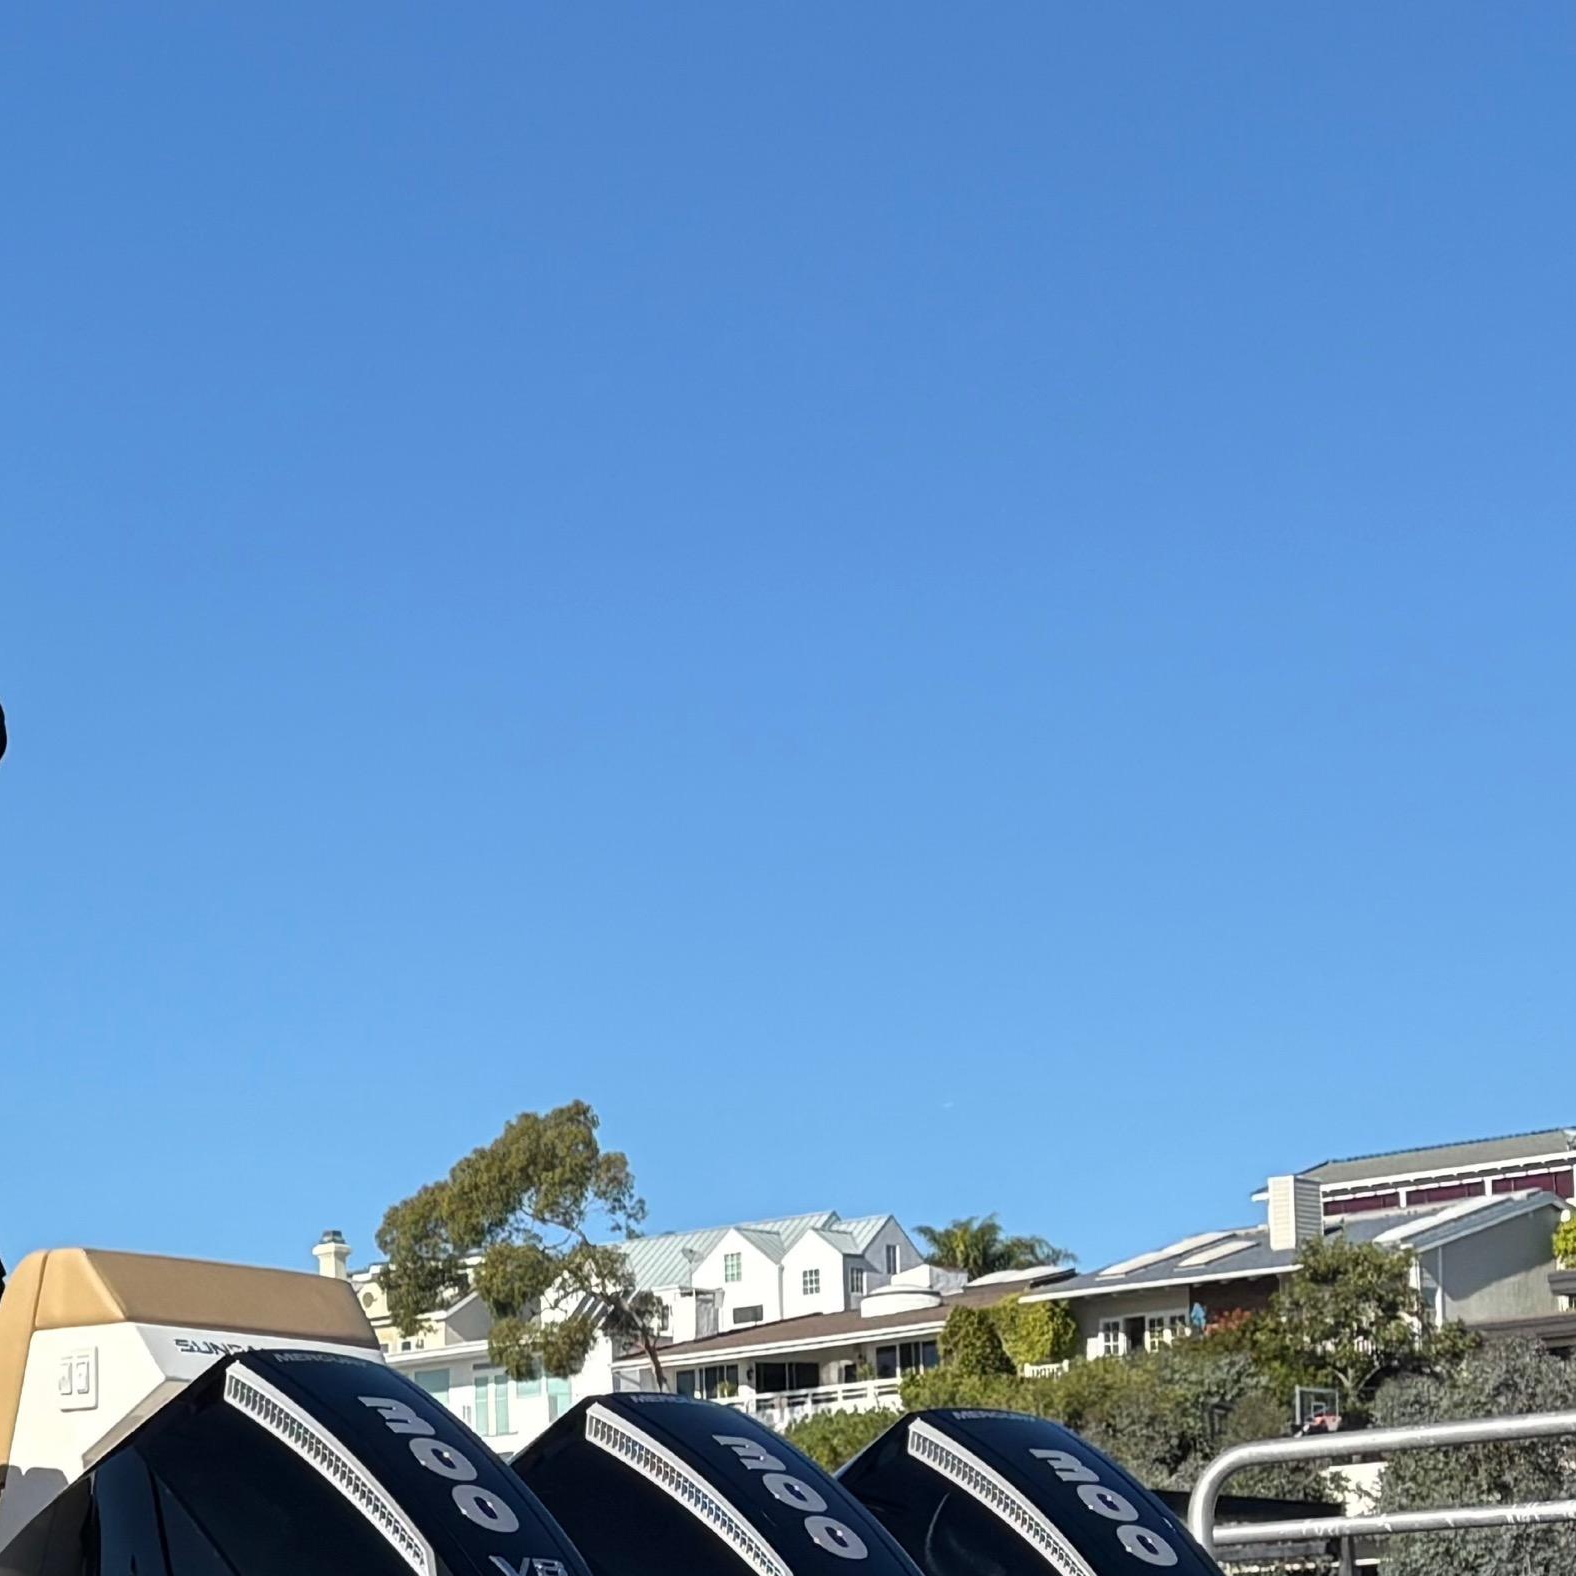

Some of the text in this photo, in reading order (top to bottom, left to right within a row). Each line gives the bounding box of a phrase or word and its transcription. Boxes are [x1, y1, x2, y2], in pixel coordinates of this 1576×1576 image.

[357, 1396, 520, 1533] 300
[712, 1434, 868, 1560] 300
[1028, 1448, 1179, 1566] 300
